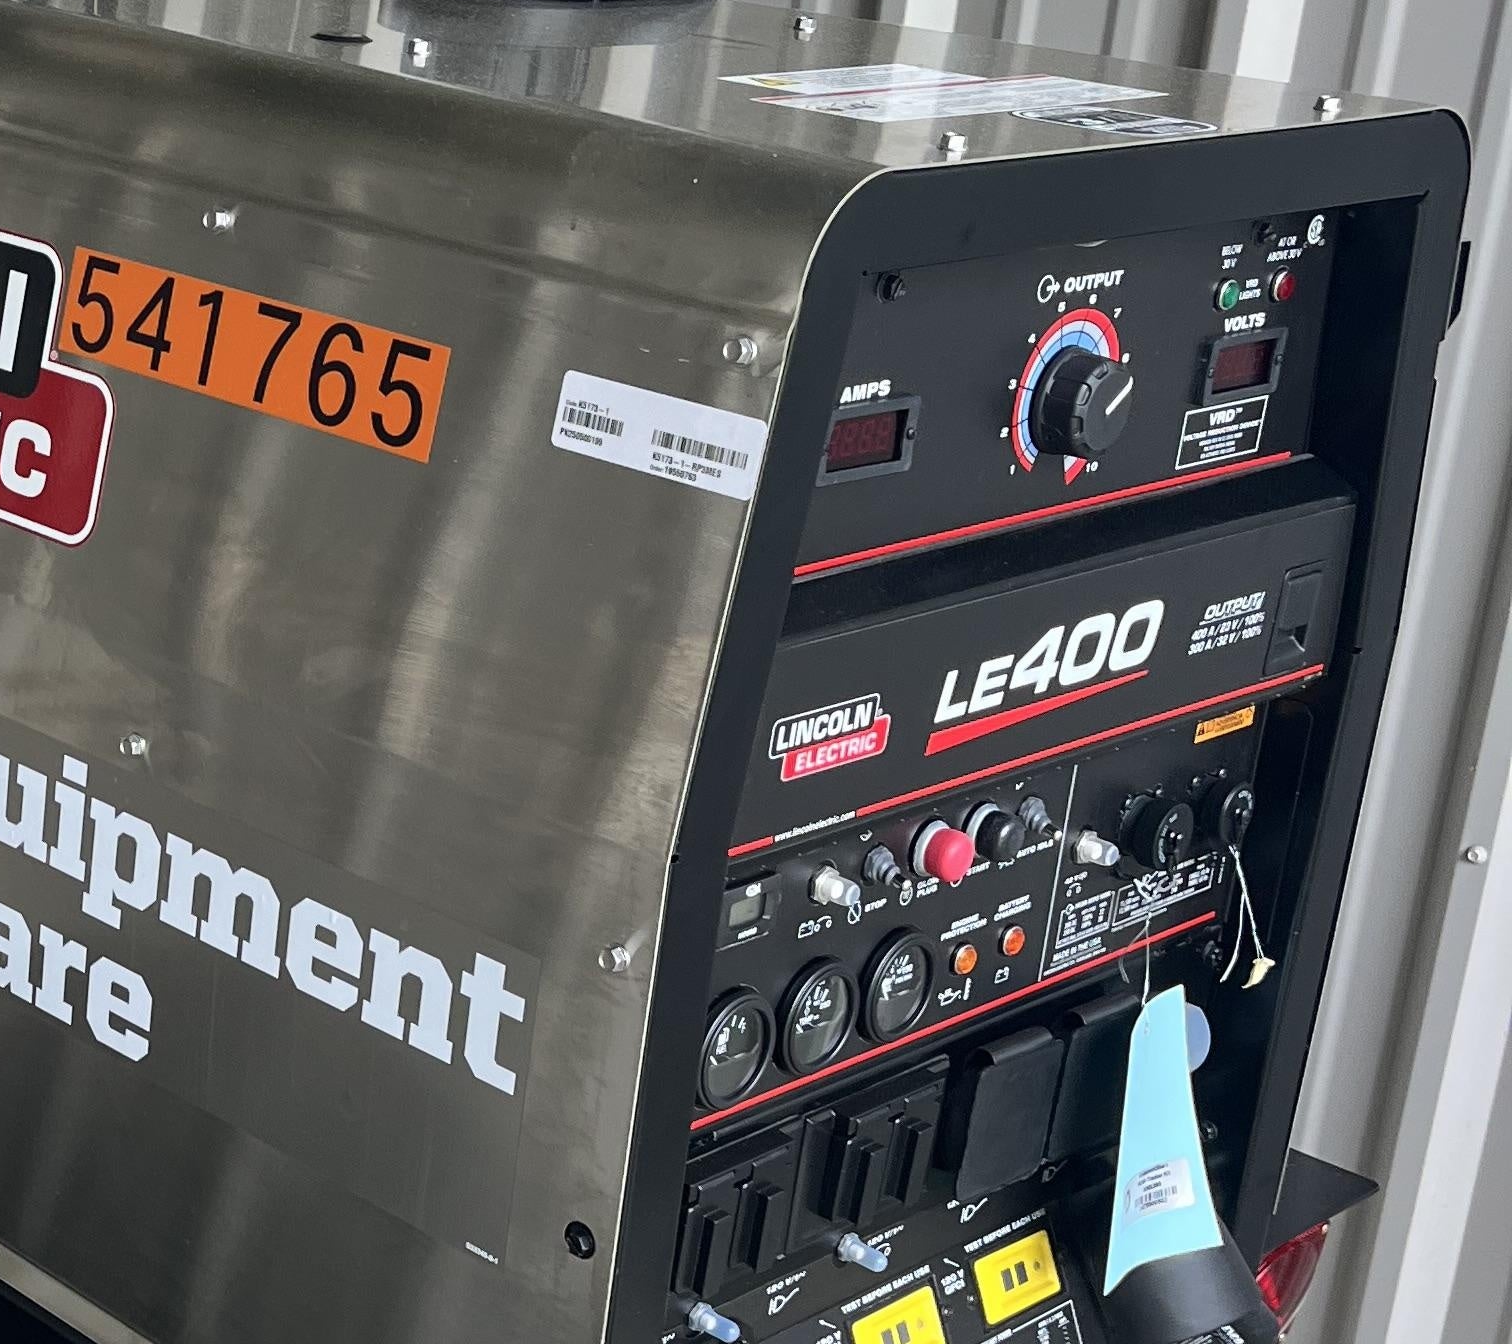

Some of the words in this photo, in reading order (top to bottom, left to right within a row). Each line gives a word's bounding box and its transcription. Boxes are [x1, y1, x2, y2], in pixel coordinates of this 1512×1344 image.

[1064, 270, 1124, 292] OUTPUT
[1057, 302, 1066, 312] 5
[1113, 308, 1122, 318] 7
[1224, 312, 1266, 333] VOLTS
[1028, 334, 1036, 344] 4
[71, 258, 432, 447] 541765
[840, 379, 891, 403] AMPS
[1008, 379, 1017, 390] 3
[1000, 427, 1009, 438] 2
[1009, 465, 1016, 475] 1
[1085, 461, 1098, 472] 10
[1203, 592, 1265, 621] OUTPUT
[934, 599, 1165, 724] LE400
[776, 702, 873, 751] LINCOLN
[794, 732, 878, 773] ELECTRIC
[774, 811, 856, 842] www.lincolnelectric.com
[1016, 845, 1037, 859] AUTO
[966, 861, 990, 877] START
[916, 877, 939, 889] GLOW
[916, 885, 938, 898] PLUG
[864, 898, 888, 913] STOP
[993, 901, 1033, 922] CHARGING
[998, 894, 1031, 914] BATTERY
[940, 918, 988, 942] PROTECTION
[950, 913, 980, 930] ENGINE
[964, 1238, 983, 1253] TEST
[982, 1224, 1012, 1245] BEFORE
[1011, 1215, 1032, 1230] EACH
[940, 1273, 957, 1287] 120
[944, 1278, 966, 1295] GFCI
[841, 1299, 862, 1315] TEST
[862, 1286, 892, 1307] BEFORE
[891, 1275, 914, 1293] EACH
[913, 1264, 930, 1282] USE
